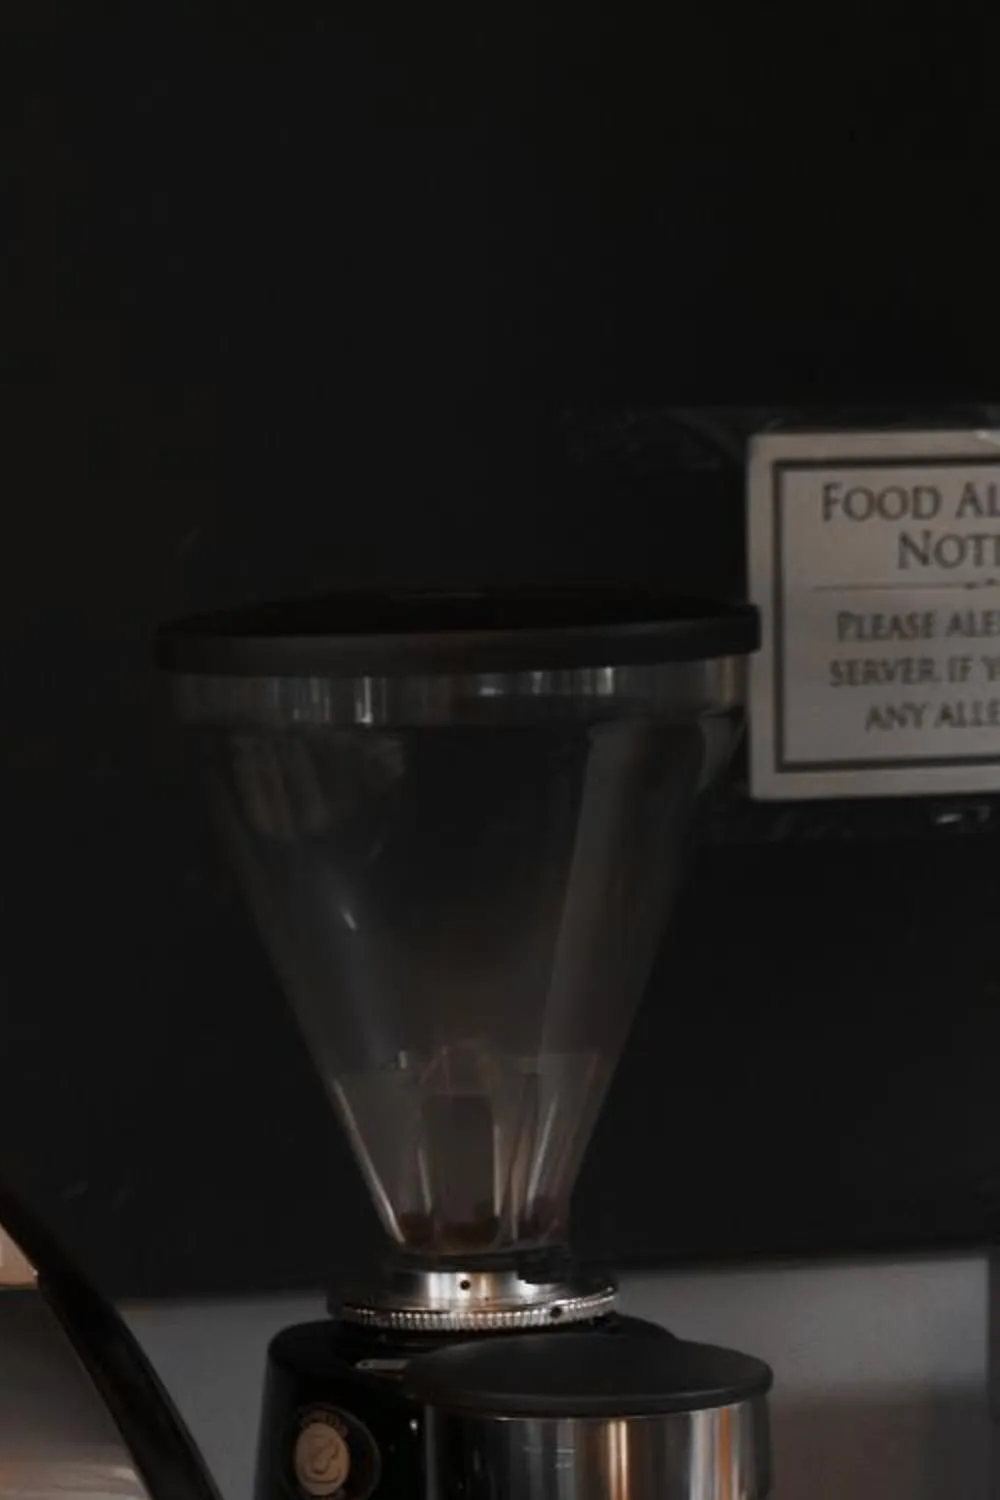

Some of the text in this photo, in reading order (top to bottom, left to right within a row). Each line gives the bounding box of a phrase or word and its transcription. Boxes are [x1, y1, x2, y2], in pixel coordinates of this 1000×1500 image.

[821, 481, 1000, 522] FOOD AL
[836, 608, 1000, 643] PLEASE ALE
[828, 656, 942, 688] SERVER
[947, 654, 974, 684] IF
[865, 698, 1000, 734] ANY ALLE
